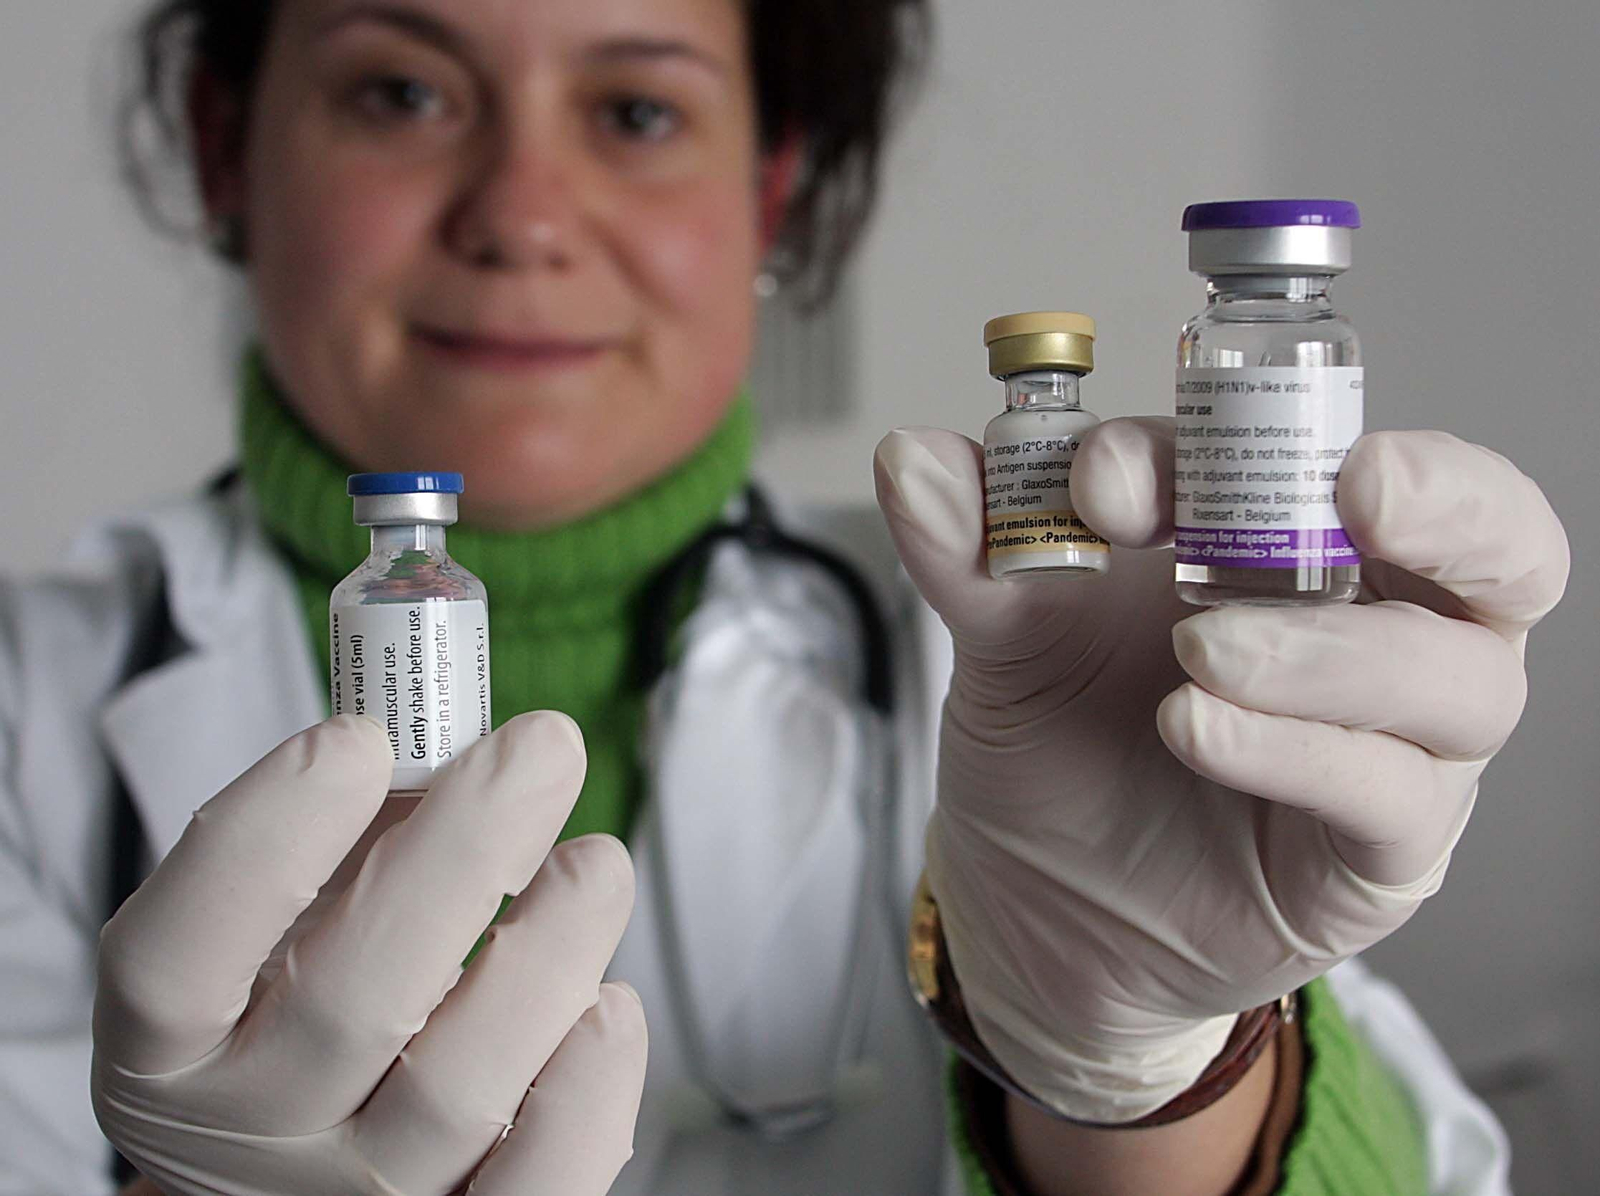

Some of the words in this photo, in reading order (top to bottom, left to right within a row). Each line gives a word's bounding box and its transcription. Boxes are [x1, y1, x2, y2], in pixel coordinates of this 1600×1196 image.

[1284, 381, 1310, 393] virus
[1207, 426, 1250, 437] emulsion
[1254, 425, 1290, 438] before
[1293, 427, 1315, 438] use.
[994, 443, 1020, 456] storage
[1240, 449, 1253, 460] do
[1257, 449, 1273, 460] not
[1315, 449, 1344, 461] protect
[997, 463, 1024, 475] Antigen
[1027, 460, 1072, 472] suspensio
[1203, 470, 1243, 484] adjuvant
[1304, 470, 1316, 481] 10
[1008, 495, 1042, 507] Belgium
[1193, 492, 1272, 504] GlaxoSmithKline
[1274, 491, 1330, 506] Biologicals
[1007, 516, 1051, 530] emulsion
[1053, 515, 1068, 527] for
[1245, 508, 1291, 524] Belgium
[1219, 530, 1235, 543] for
[1237, 530, 1289, 545] injection
[408, 606, 421, 632] use.
[333, 613, 341, 677] Vaccine
[476, 623, 485, 650] S.r.l.
[351, 634, 365, 670] (5ml)
[384, 642, 396, 670] use.
[406, 634, 423, 674] before
[434, 620, 452, 696] refrigerator.
[477, 653, 486, 681] V&D
[352, 672, 366, 696] vial
[408, 678, 425, 713] shake
[436, 709, 450, 723] in
[475, 684, 487, 736] Novartis
[409, 716, 428, 760] Gently
[437, 726, 451, 758] Store
